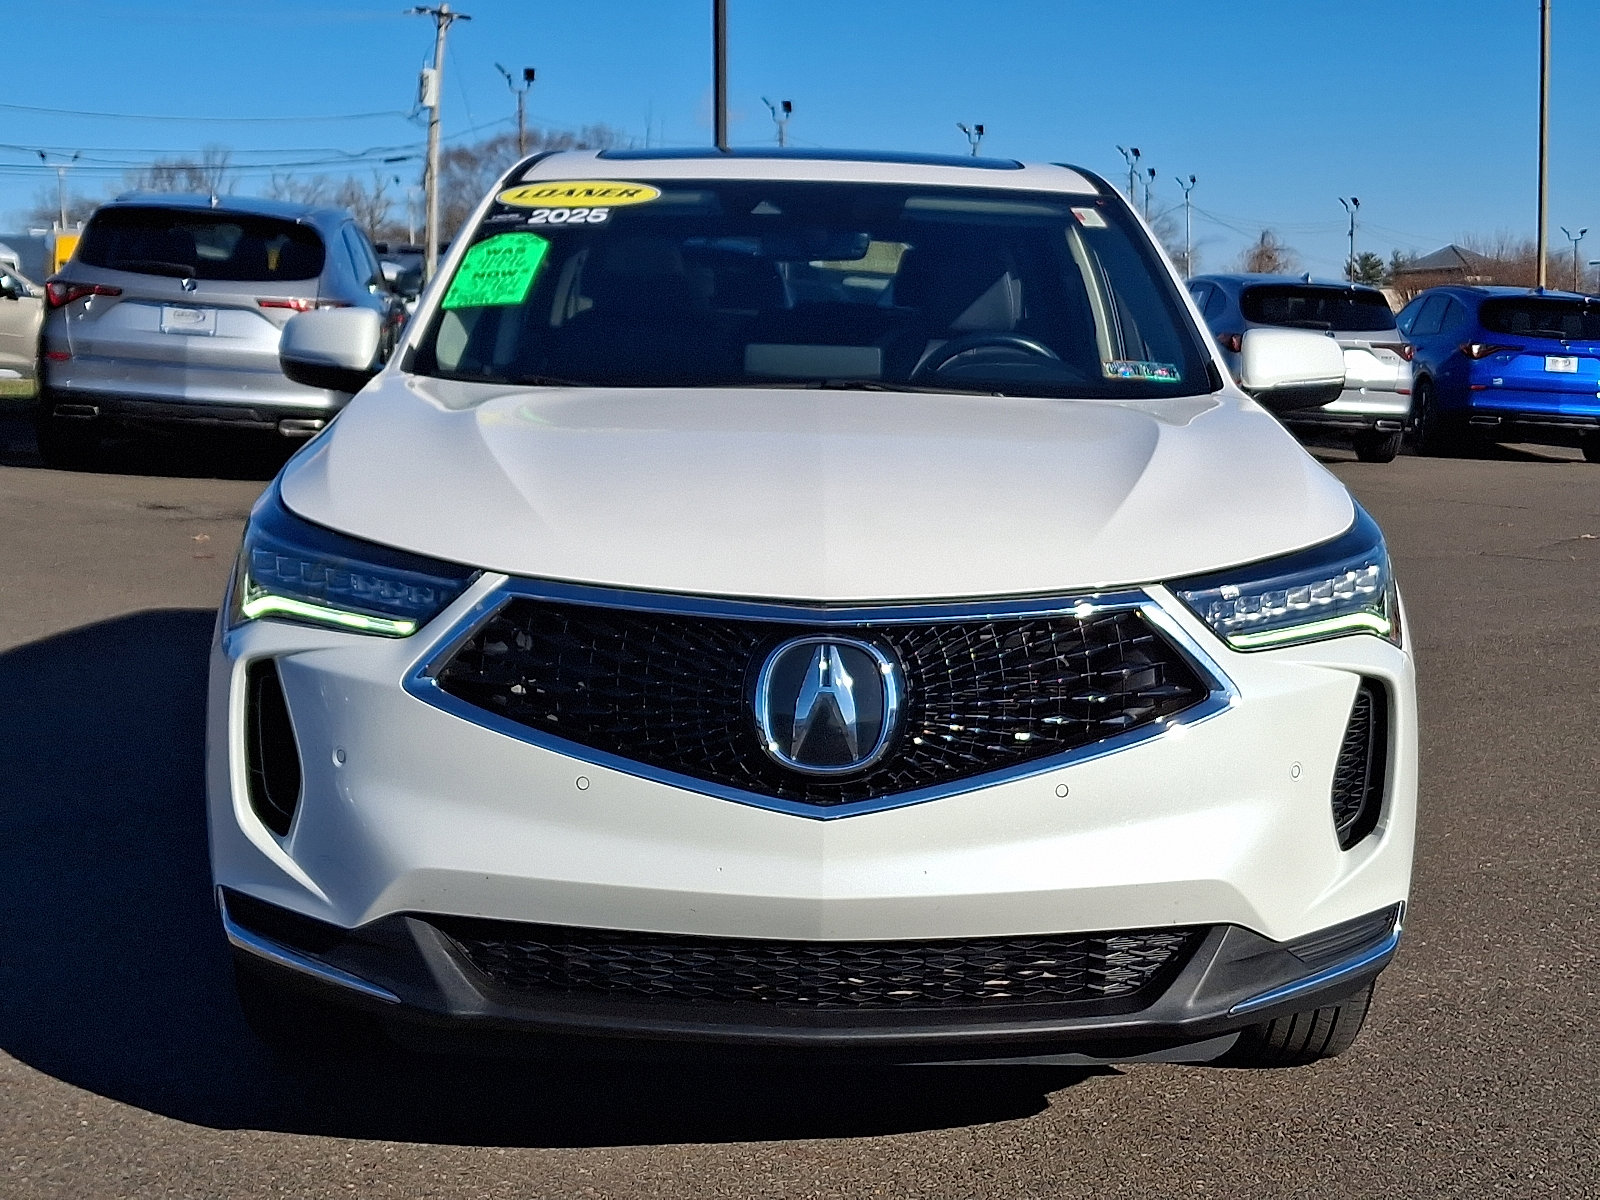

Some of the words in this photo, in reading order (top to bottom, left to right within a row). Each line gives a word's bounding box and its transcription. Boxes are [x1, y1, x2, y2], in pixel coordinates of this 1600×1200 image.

[514, 188, 642, 200] LOANER
[527, 208, 609, 224] 2025
[472, 268, 519, 280] NOW
